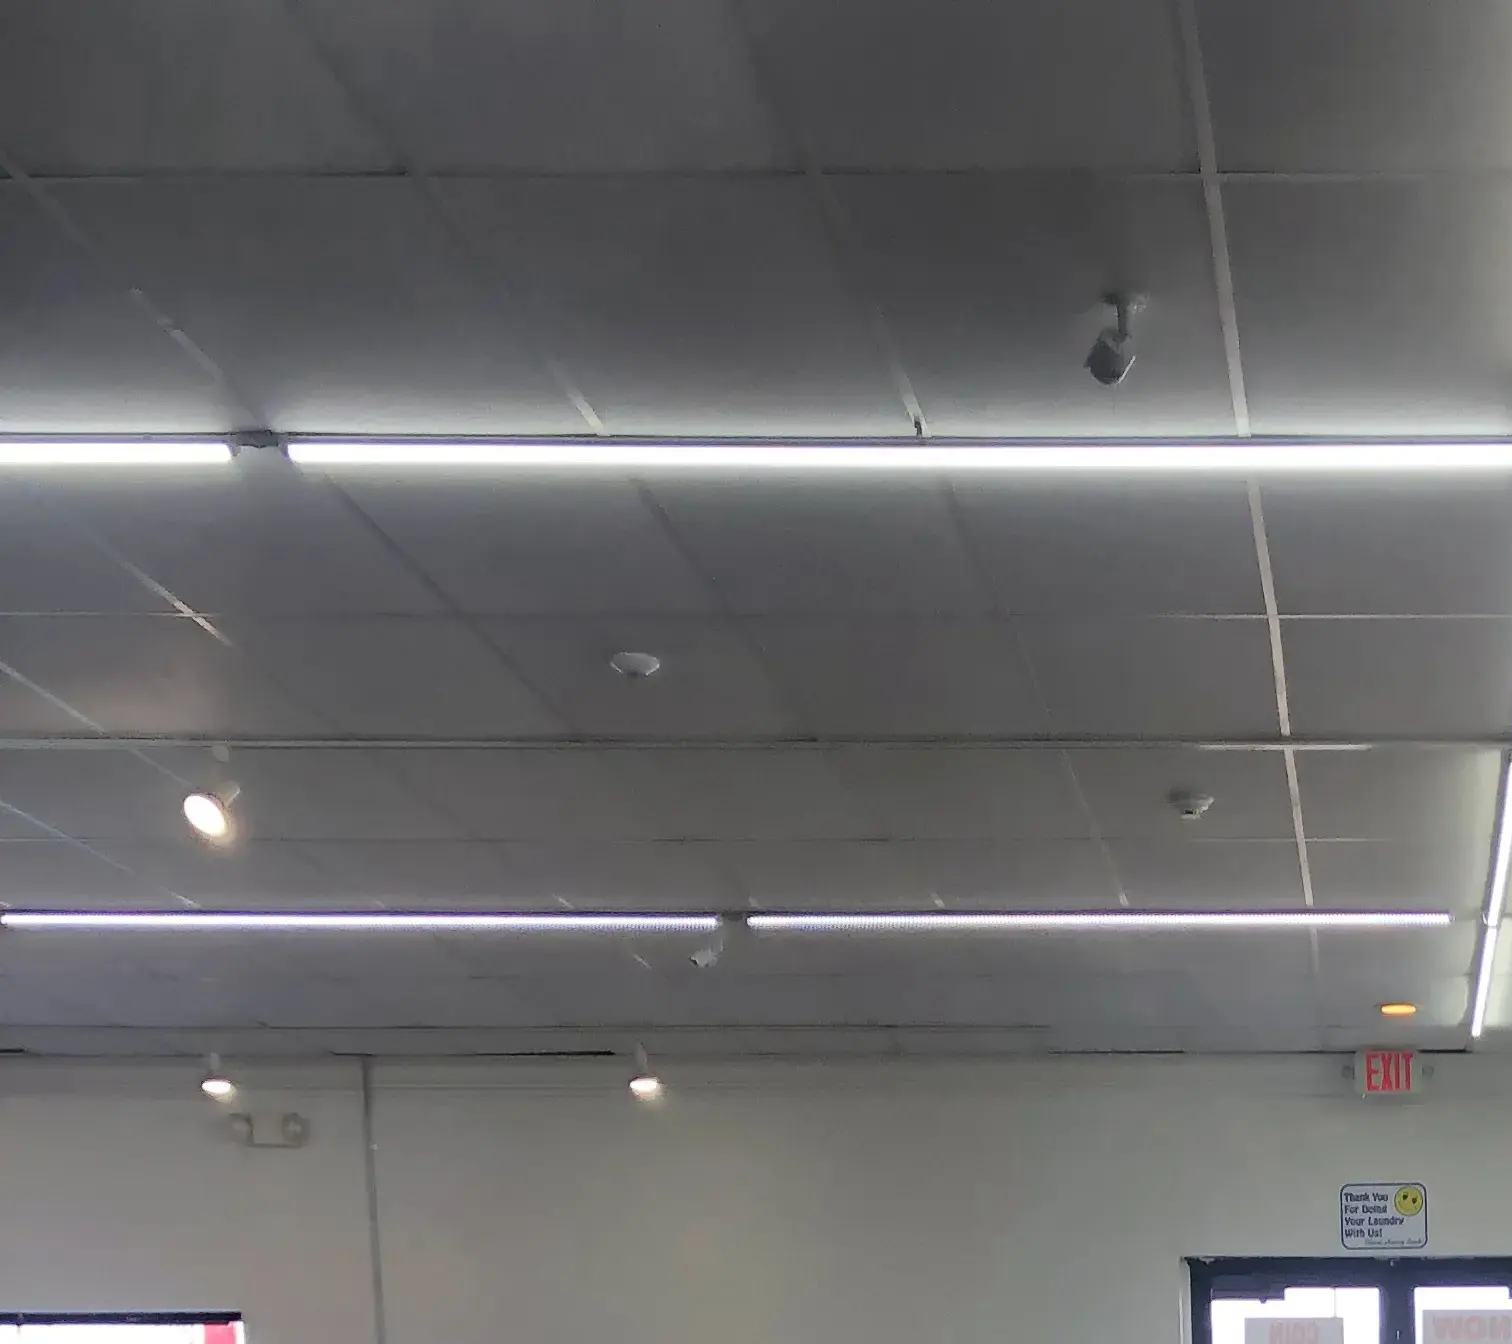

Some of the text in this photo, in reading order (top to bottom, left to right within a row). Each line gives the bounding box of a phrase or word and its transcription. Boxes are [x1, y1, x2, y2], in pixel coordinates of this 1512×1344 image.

[1366, 1051, 1414, 1092] EXIT
[1344, 1192, 1389, 1202] Thank You
[1344, 1205, 1359, 1215] For
[1344, 1216, 1405, 1227] Your Laundry
[1344, 1228, 1366, 1238] With
